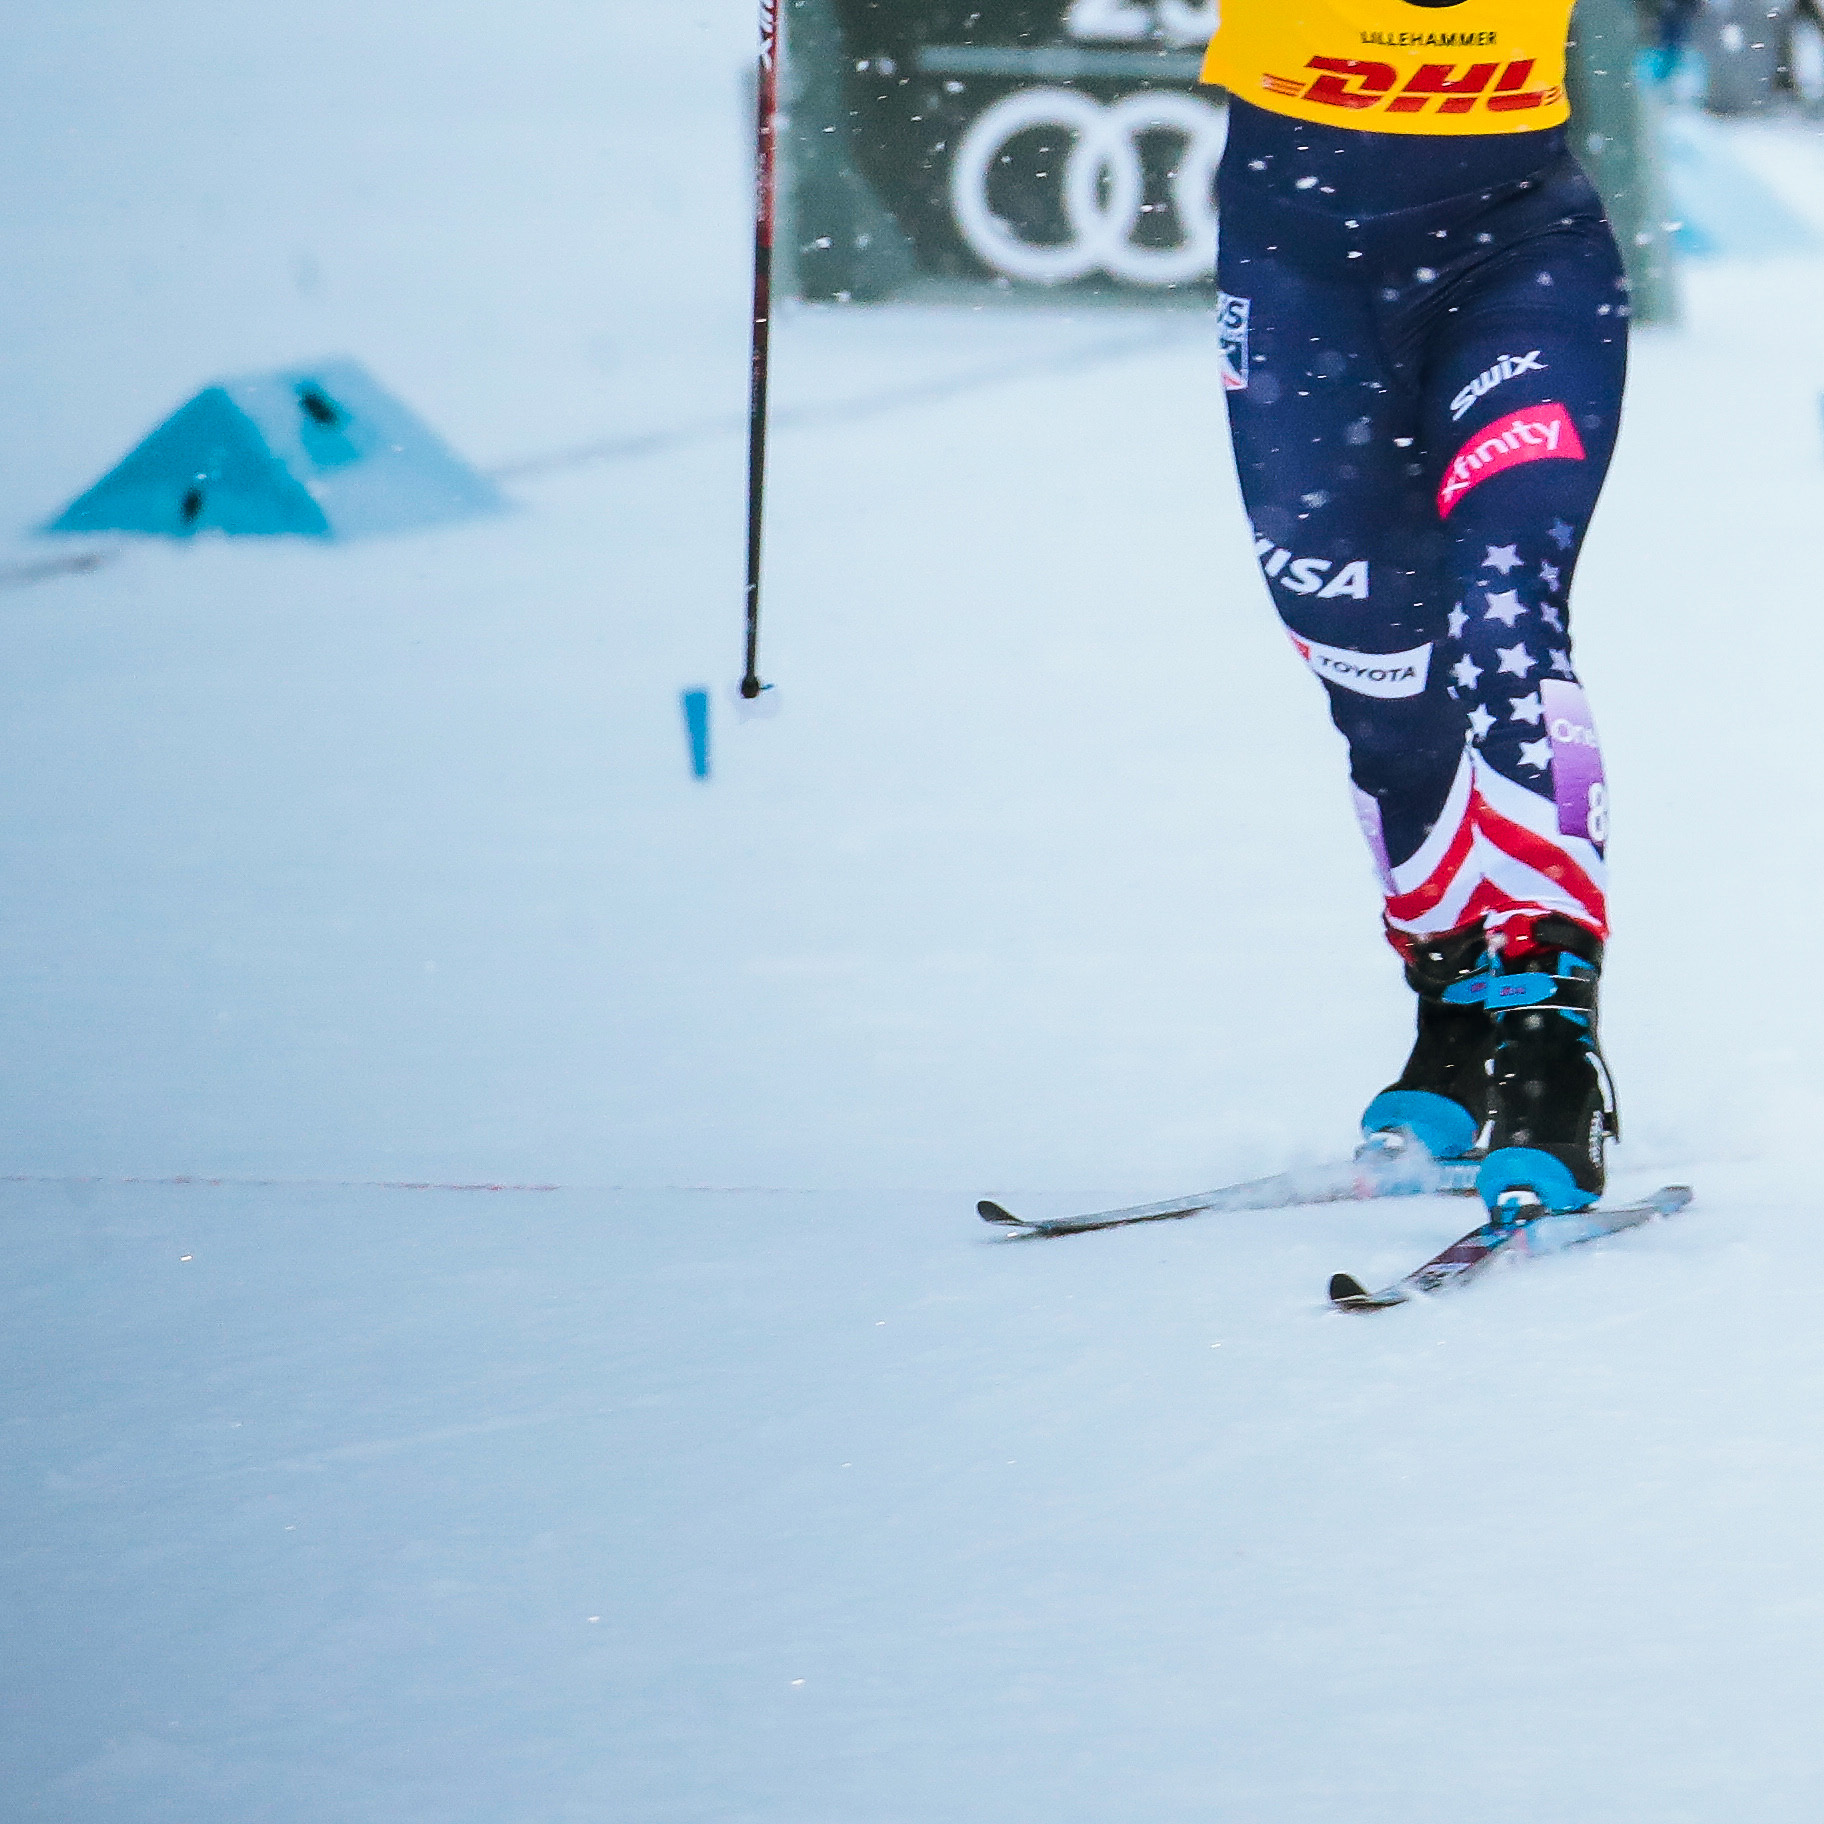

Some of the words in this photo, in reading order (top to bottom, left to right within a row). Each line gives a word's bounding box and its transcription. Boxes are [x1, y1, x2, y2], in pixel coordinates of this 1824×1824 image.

[1360, 31, 1498, 48] LILLEHAMMER
[1300, 55, 1550, 115] DHL
[1441, 419, 1562, 504] xfinity
[1317, 656, 1417, 682] TOYOTA
